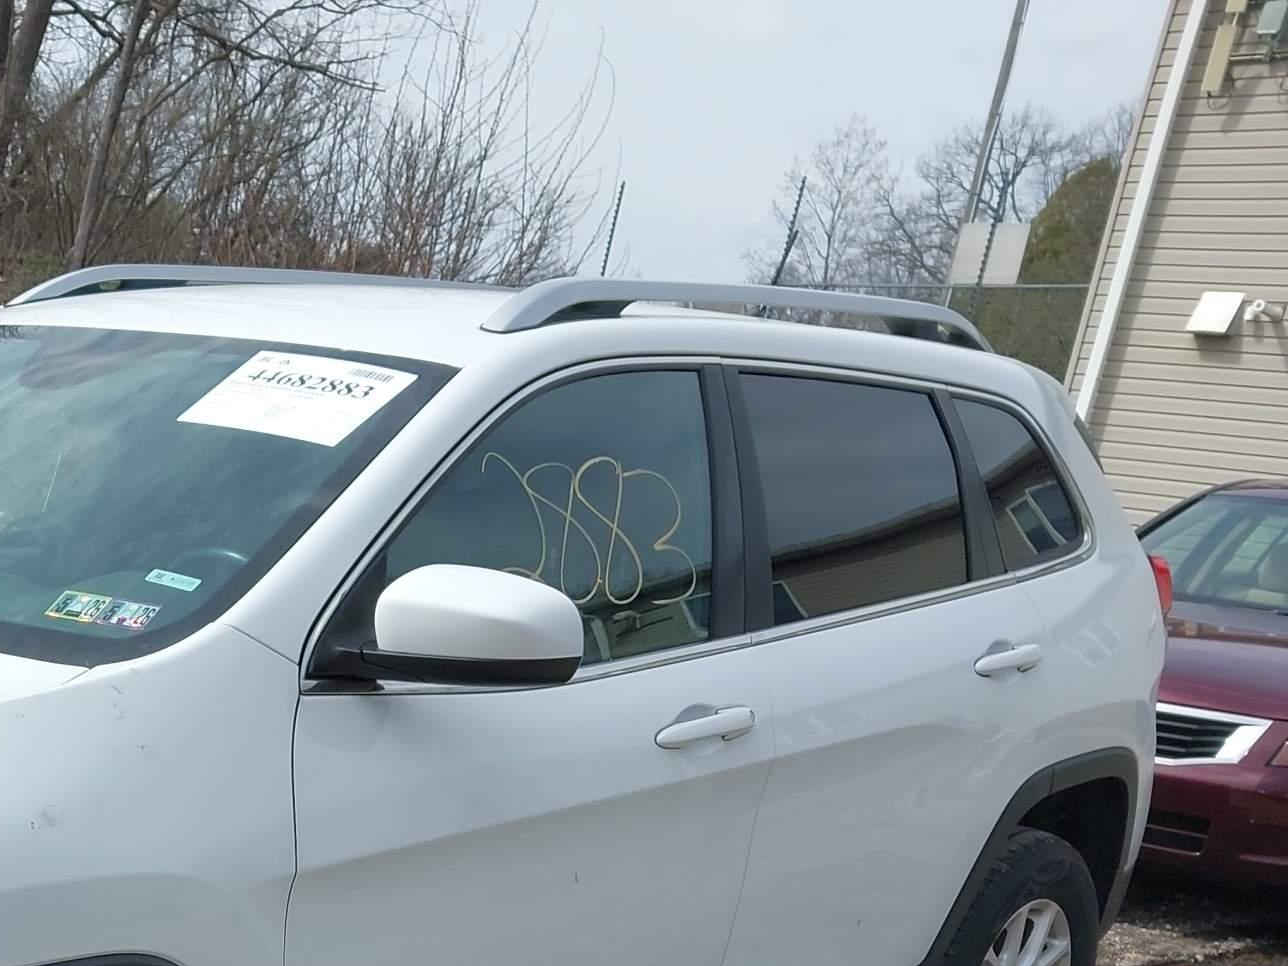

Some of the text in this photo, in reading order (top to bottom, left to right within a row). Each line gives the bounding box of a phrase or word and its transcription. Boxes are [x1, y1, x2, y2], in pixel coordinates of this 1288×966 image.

[247, 368, 376, 399] 44682883
[83, 599, 106, 618] 26
[133, 606, 157, 626] 26
